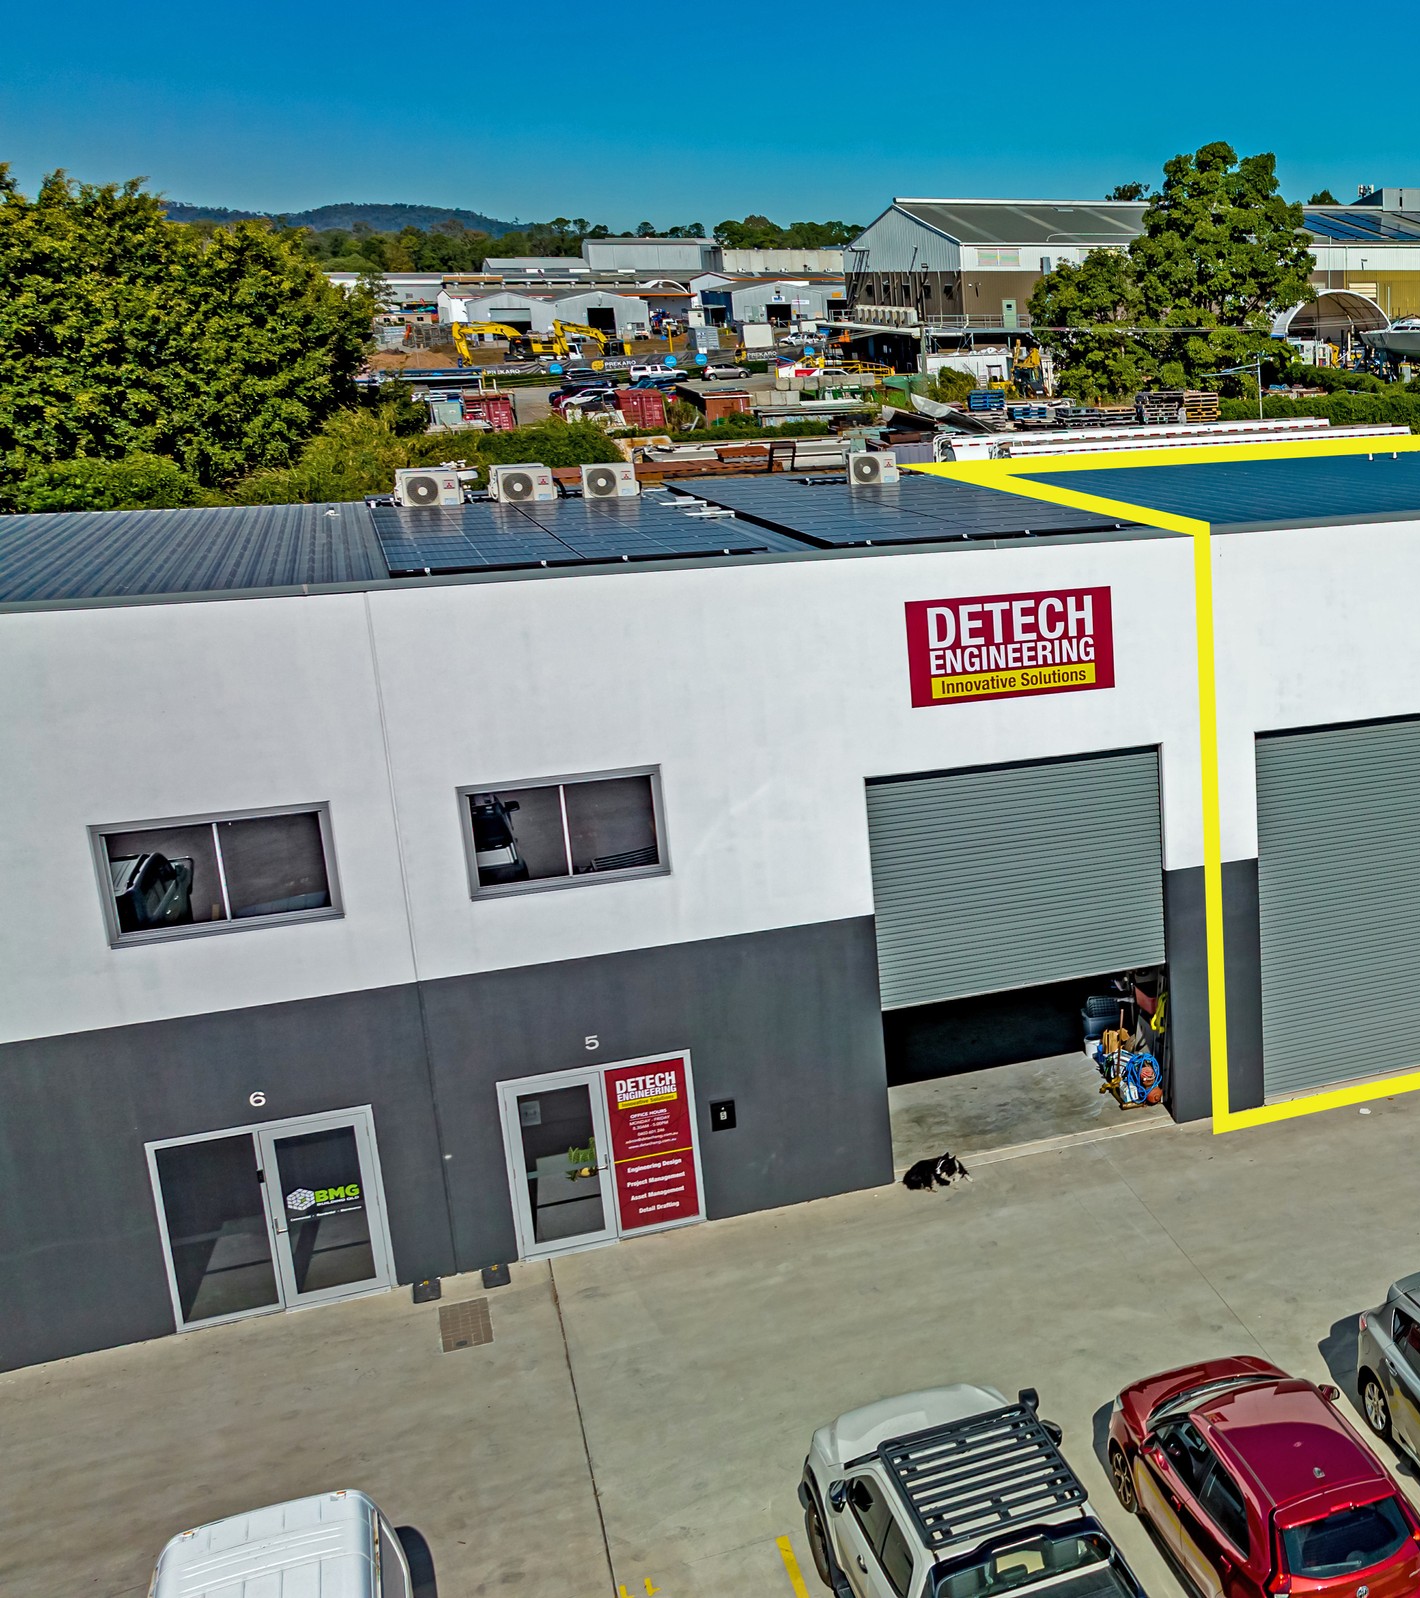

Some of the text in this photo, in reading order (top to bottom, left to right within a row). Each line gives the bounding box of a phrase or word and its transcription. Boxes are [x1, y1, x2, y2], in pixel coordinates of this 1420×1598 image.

[927, 595, 1094, 649] DETECH
[929, 637, 1095, 675] ENGINEERING
[942, 668, 1087, 694] Innovative Solutions
[585, 1034, 600, 1050] 5
[615, 1071, 676, 1094] DETECH
[249, 1091, 266, 1107] 6
[617, 1084, 677, 1102] ENGINEERING
[627, 1157, 682, 1174] Engineering Design
[627, 1171, 685, 1188] Project Management
[315, 1183, 360, 1203] BMG
[630, 1185, 685, 1201] Asset Management
[638, 1200, 680, 1214] Detail Drafting
